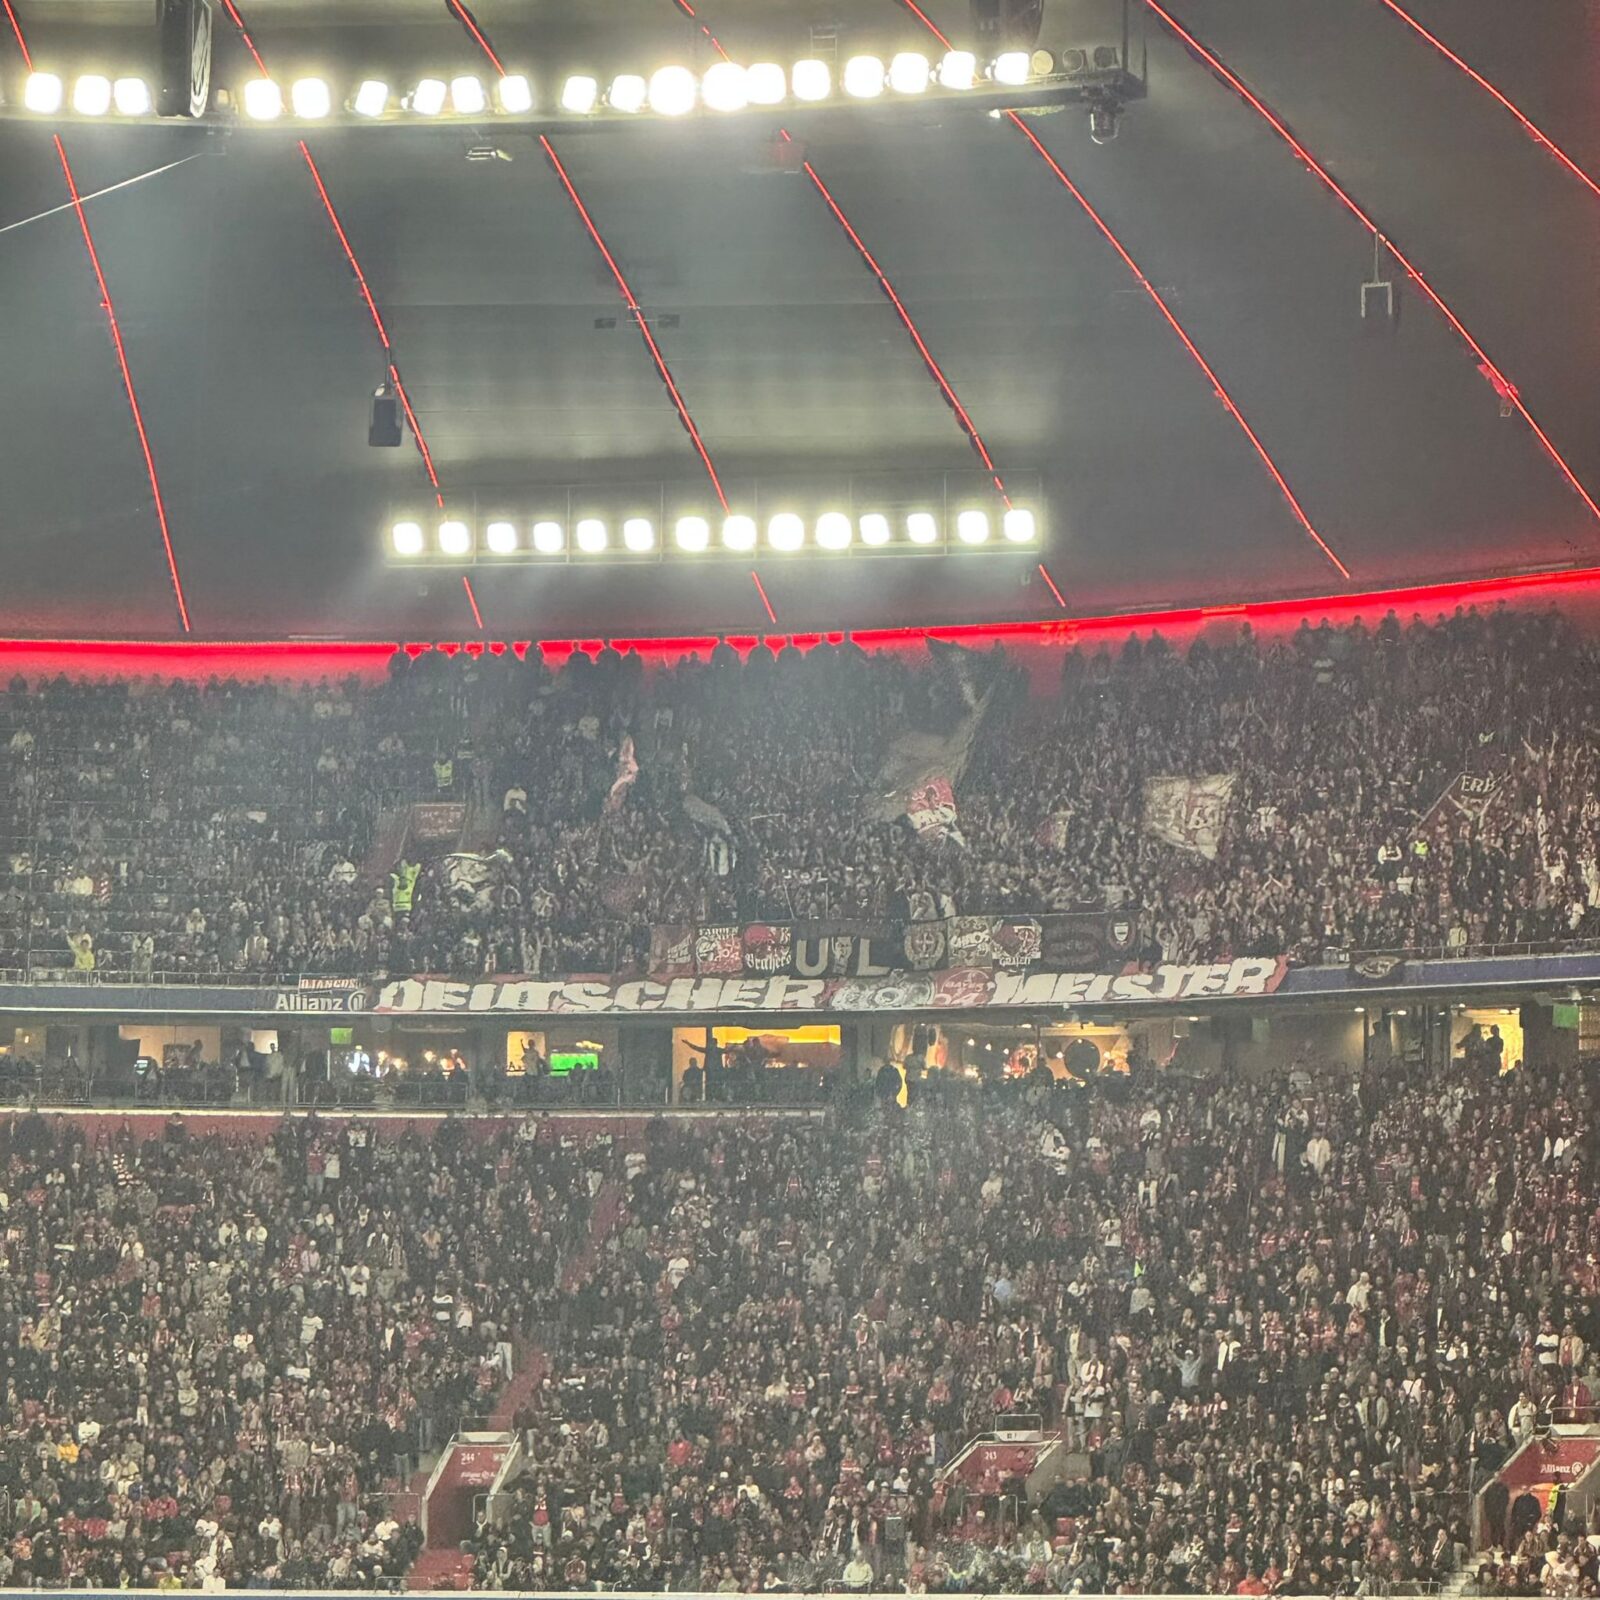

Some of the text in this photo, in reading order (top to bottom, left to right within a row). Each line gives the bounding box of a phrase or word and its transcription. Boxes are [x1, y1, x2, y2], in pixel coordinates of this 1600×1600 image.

[374, 976, 824, 1011] DEUTSCHER
[988, 957, 1277, 1005] MEISTER
[275, 993, 343, 1011] Allianz
[1540, 1463, 1571, 1474] Allianz
